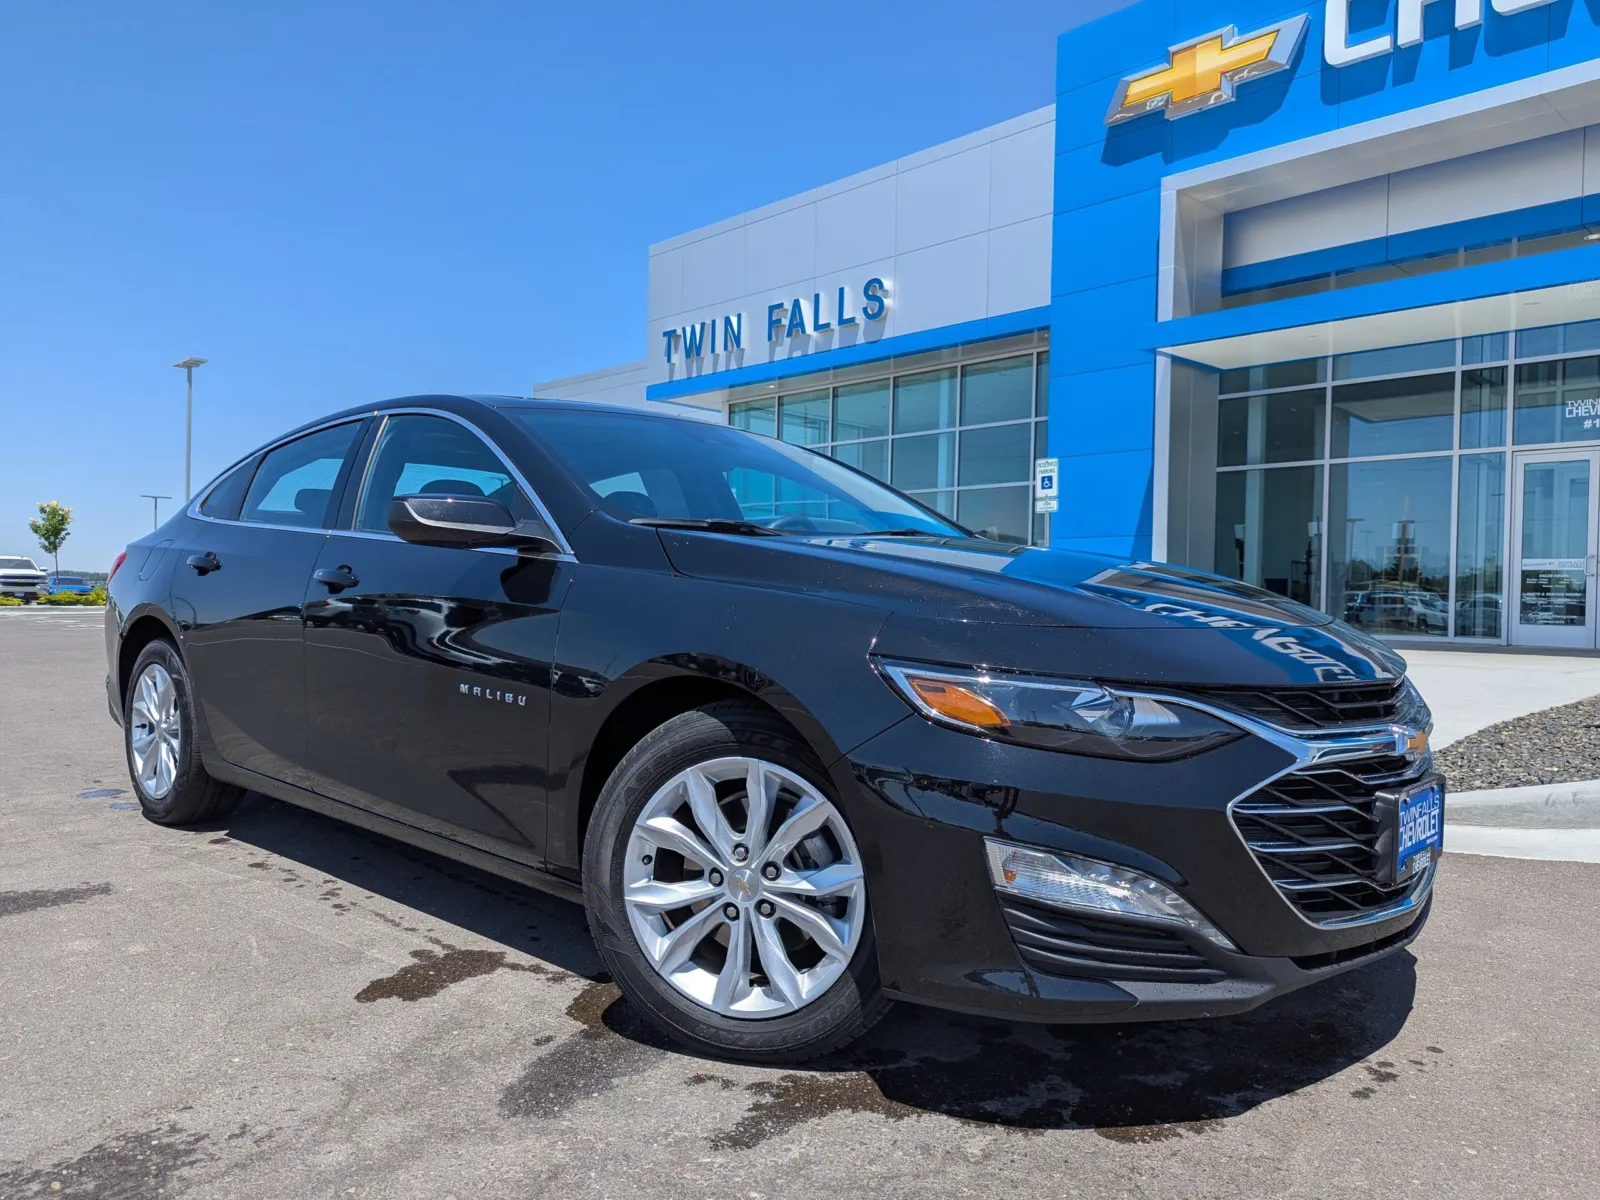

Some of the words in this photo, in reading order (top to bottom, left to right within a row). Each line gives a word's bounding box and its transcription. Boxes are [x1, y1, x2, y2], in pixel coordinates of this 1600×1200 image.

[663, 313, 742, 363] TWIN
[768, 278, 885, 341] FALLS
[1566, 398, 1600, 408] TWIN
[460, 683, 527, 707] MALIBU
[1398, 808, 1440, 853] CHEVROLET
